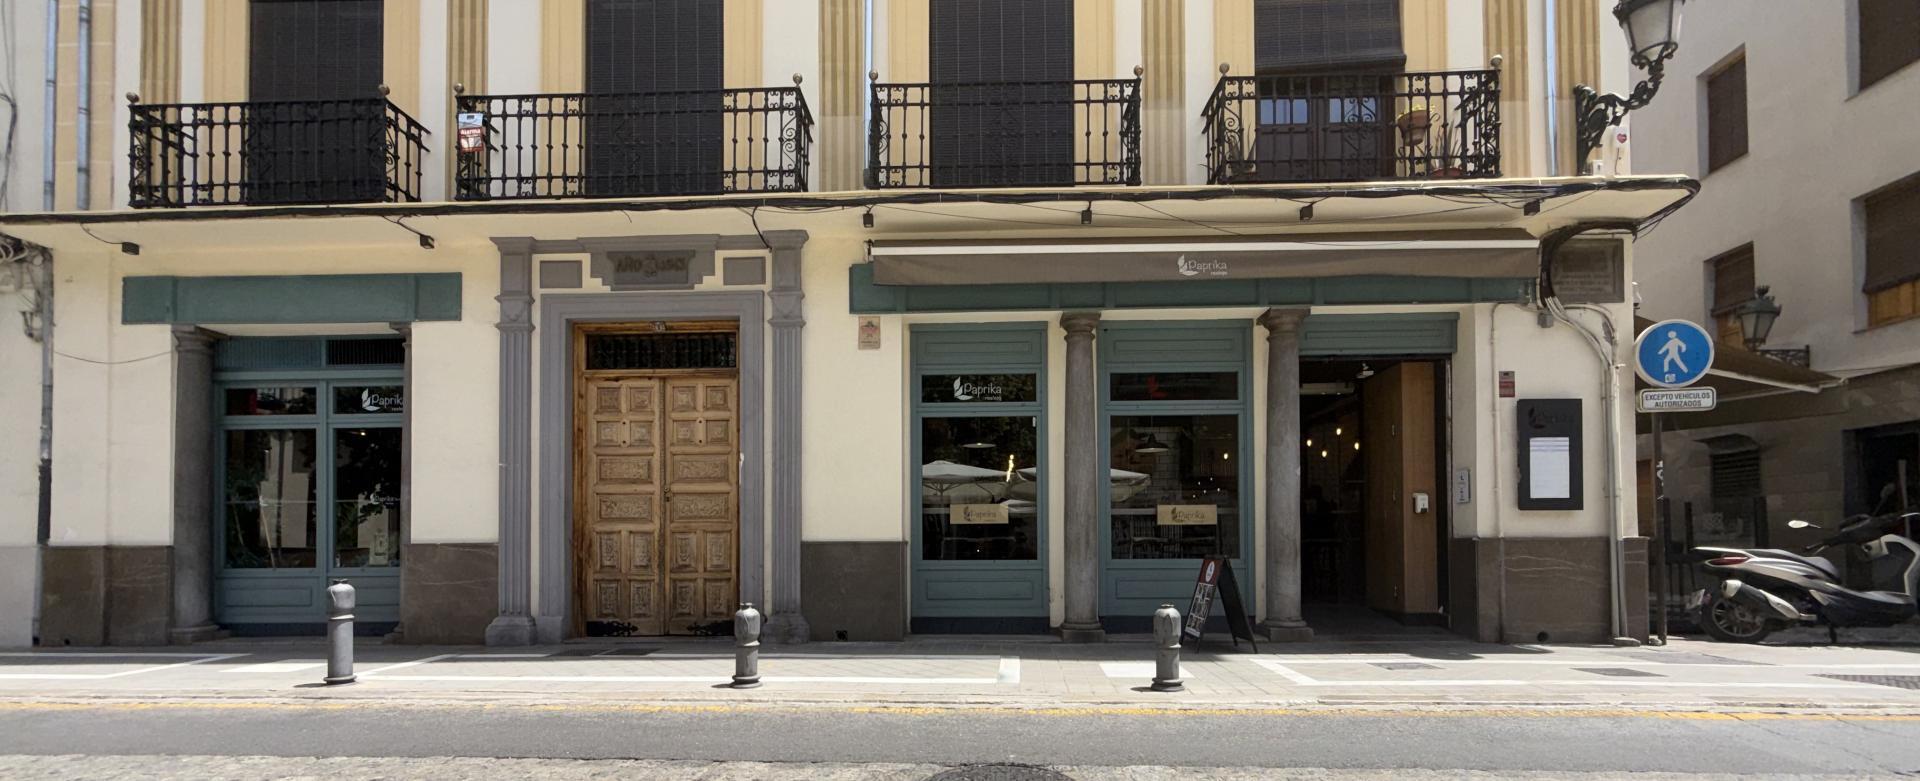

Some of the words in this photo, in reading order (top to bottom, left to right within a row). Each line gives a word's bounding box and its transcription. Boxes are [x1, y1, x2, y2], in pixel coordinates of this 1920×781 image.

[1188, 259, 1227, 273] Paprika
[963, 382, 1002, 398] Paprika
[1645, 393, 1673, 401] EXCEPTO
[1654, 400, 1702, 408] AUTORIZADOS
